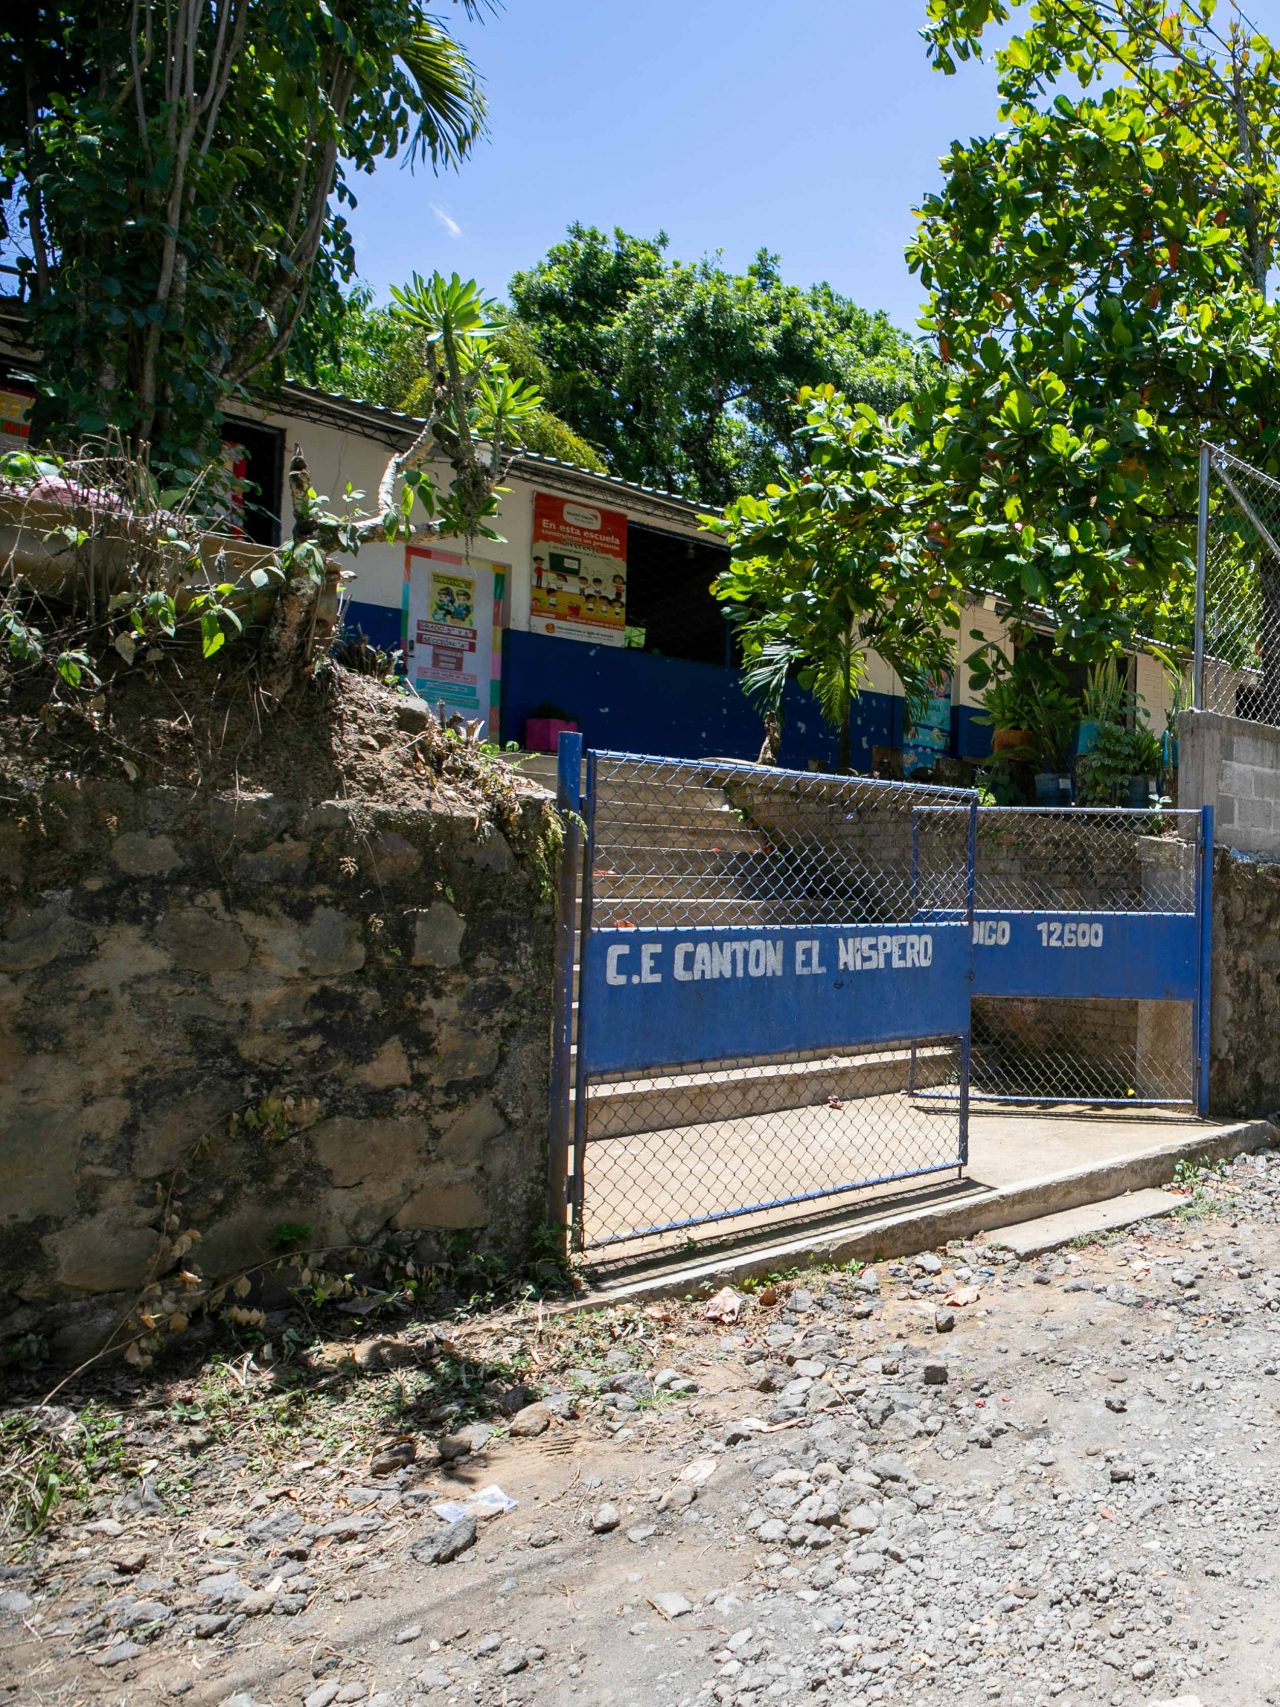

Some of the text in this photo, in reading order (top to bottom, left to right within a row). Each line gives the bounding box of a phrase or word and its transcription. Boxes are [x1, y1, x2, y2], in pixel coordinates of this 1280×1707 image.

[542, 519, 620, 545] En esta escuela
[673, 939, 784, 982] CANTON
[795, 940, 827, 975] EL
[838, 934, 933, 971] NISPERO
